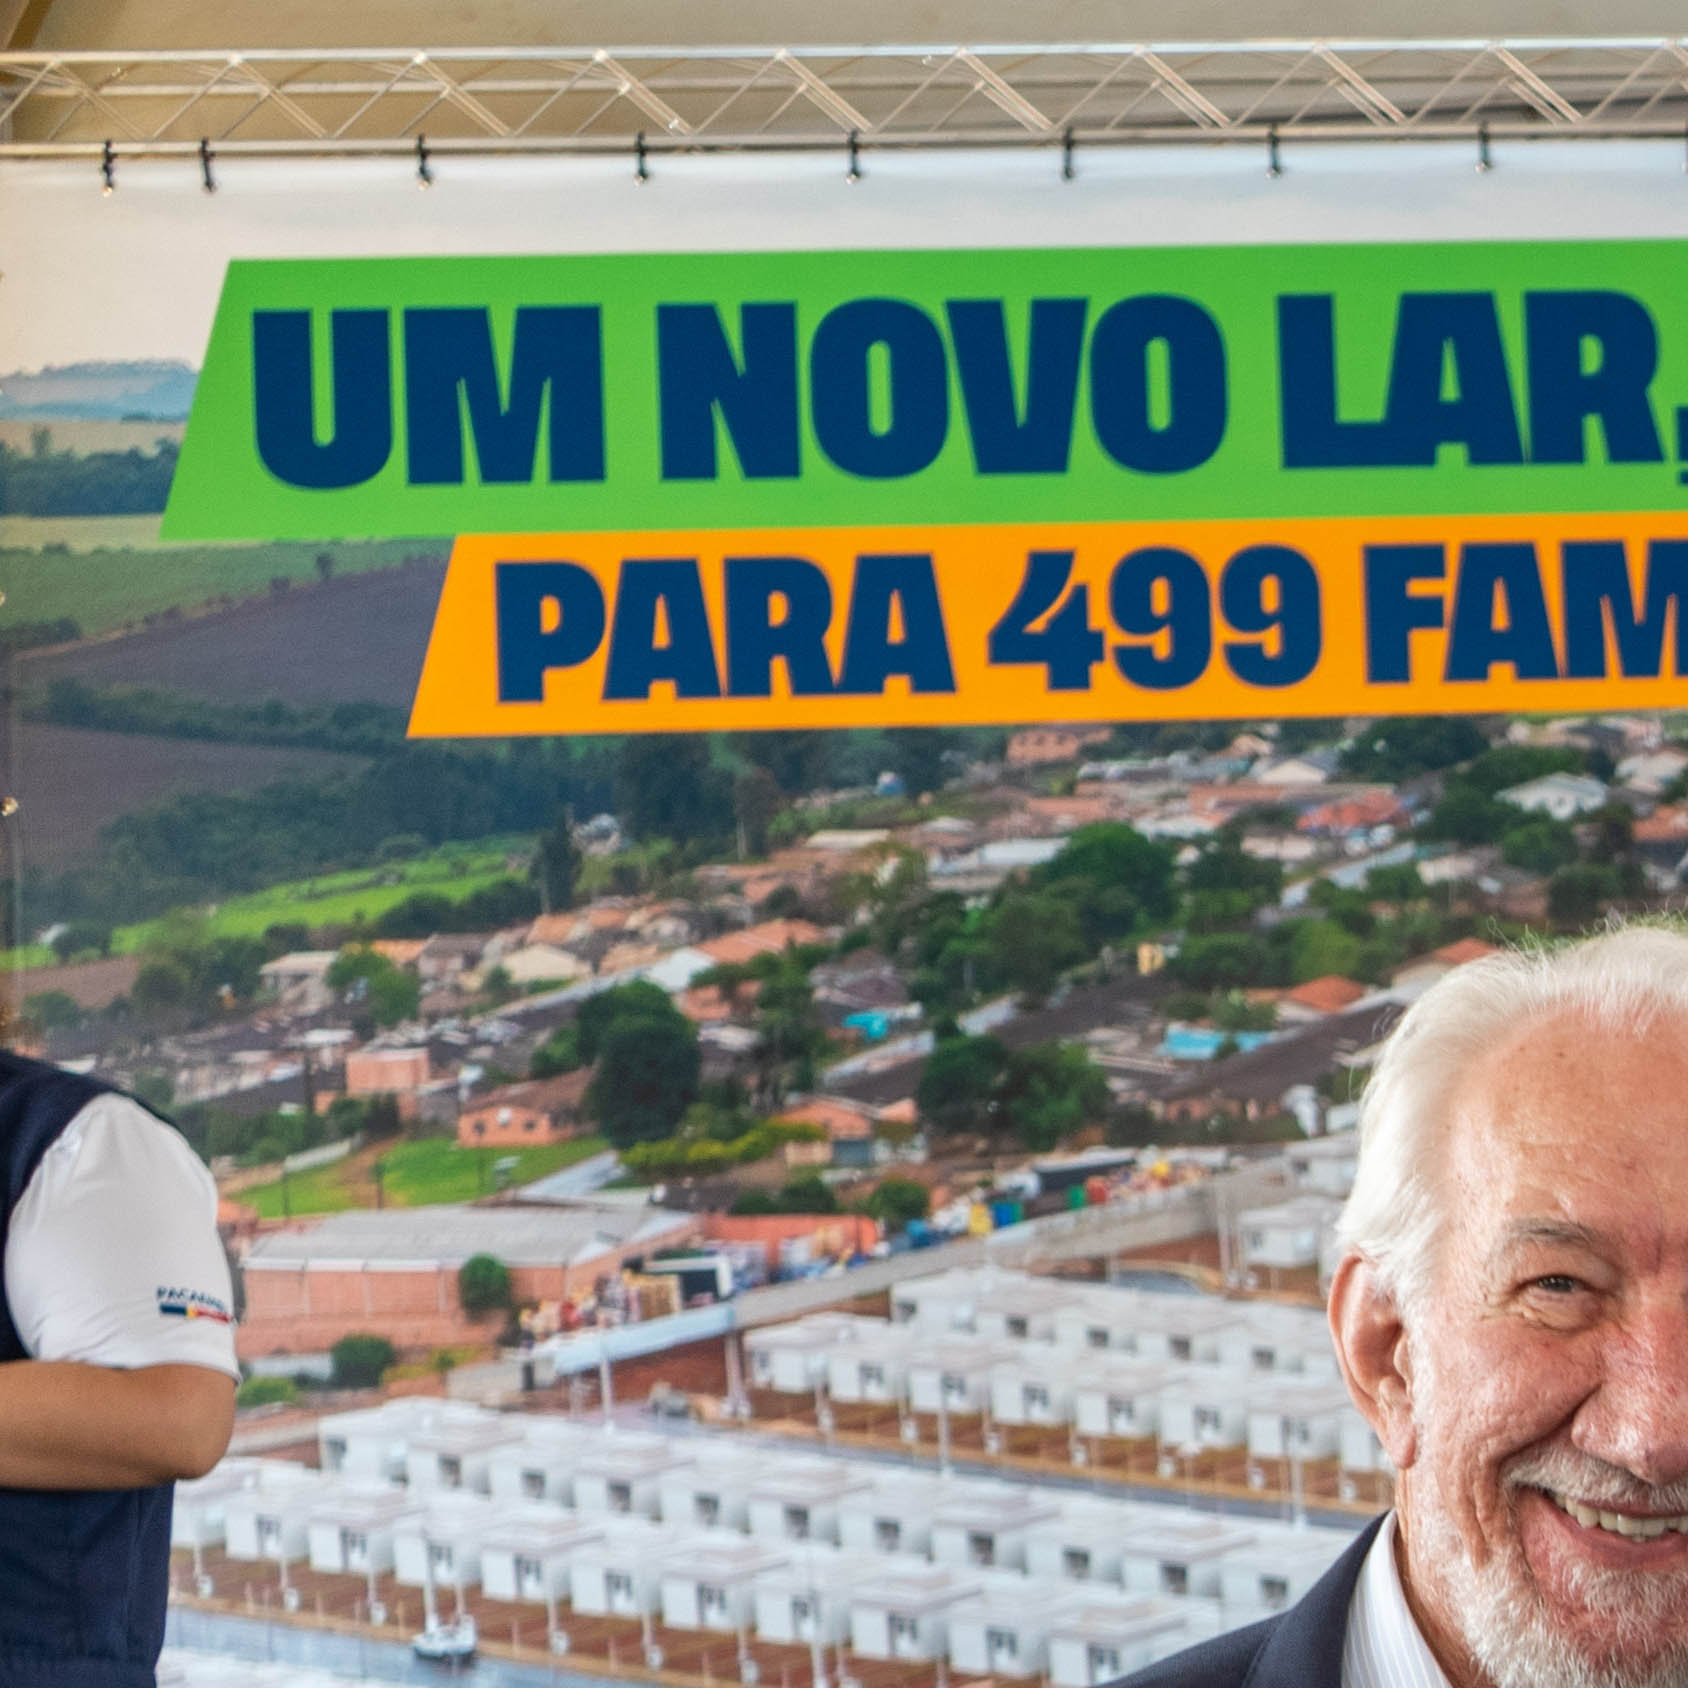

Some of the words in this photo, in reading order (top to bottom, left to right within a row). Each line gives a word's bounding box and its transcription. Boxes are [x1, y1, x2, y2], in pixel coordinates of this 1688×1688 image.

[251, 304, 607, 490] UM
[656, 293, 1229, 480] NOVO
[494, 552, 958, 704] PARA
[987, 544, 1324, 692] 499
[157, 1287, 225, 1312] PACA
